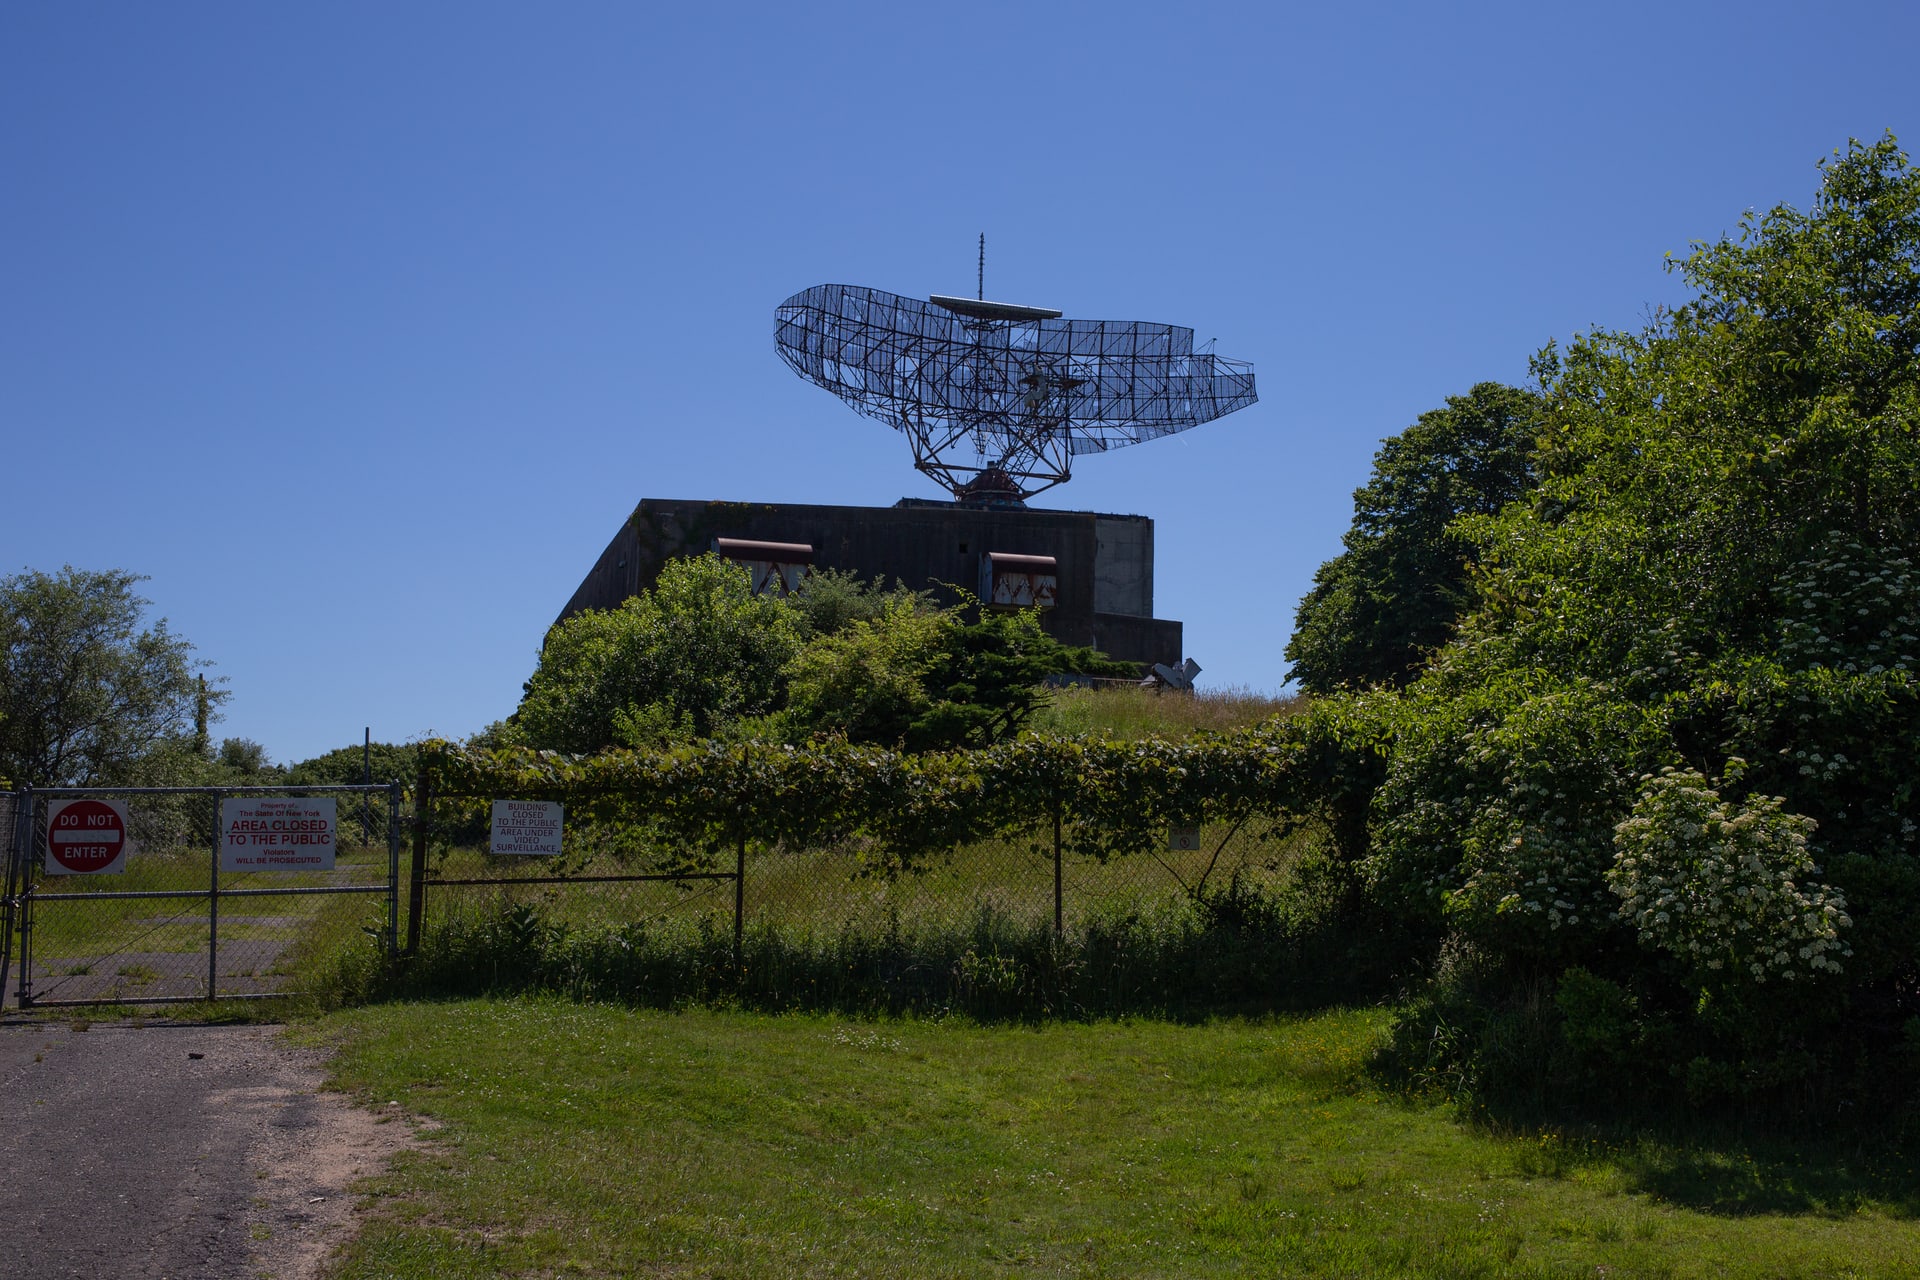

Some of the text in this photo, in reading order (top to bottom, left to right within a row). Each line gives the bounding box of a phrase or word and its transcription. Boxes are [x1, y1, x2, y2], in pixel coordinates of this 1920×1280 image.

[508, 803, 547, 811] BUILDING
[61, 815, 114, 826] DO NOT
[529, 819, 558, 827] PUBLIC
[231, 820, 328, 831] AREA CLOSED
[525, 829, 554, 837] UNDER
[228, 834, 330, 845] TO THE PUBLIC
[65, 847, 108, 858] ENTER
[496, 844, 556, 852] SURVEILLANCE
